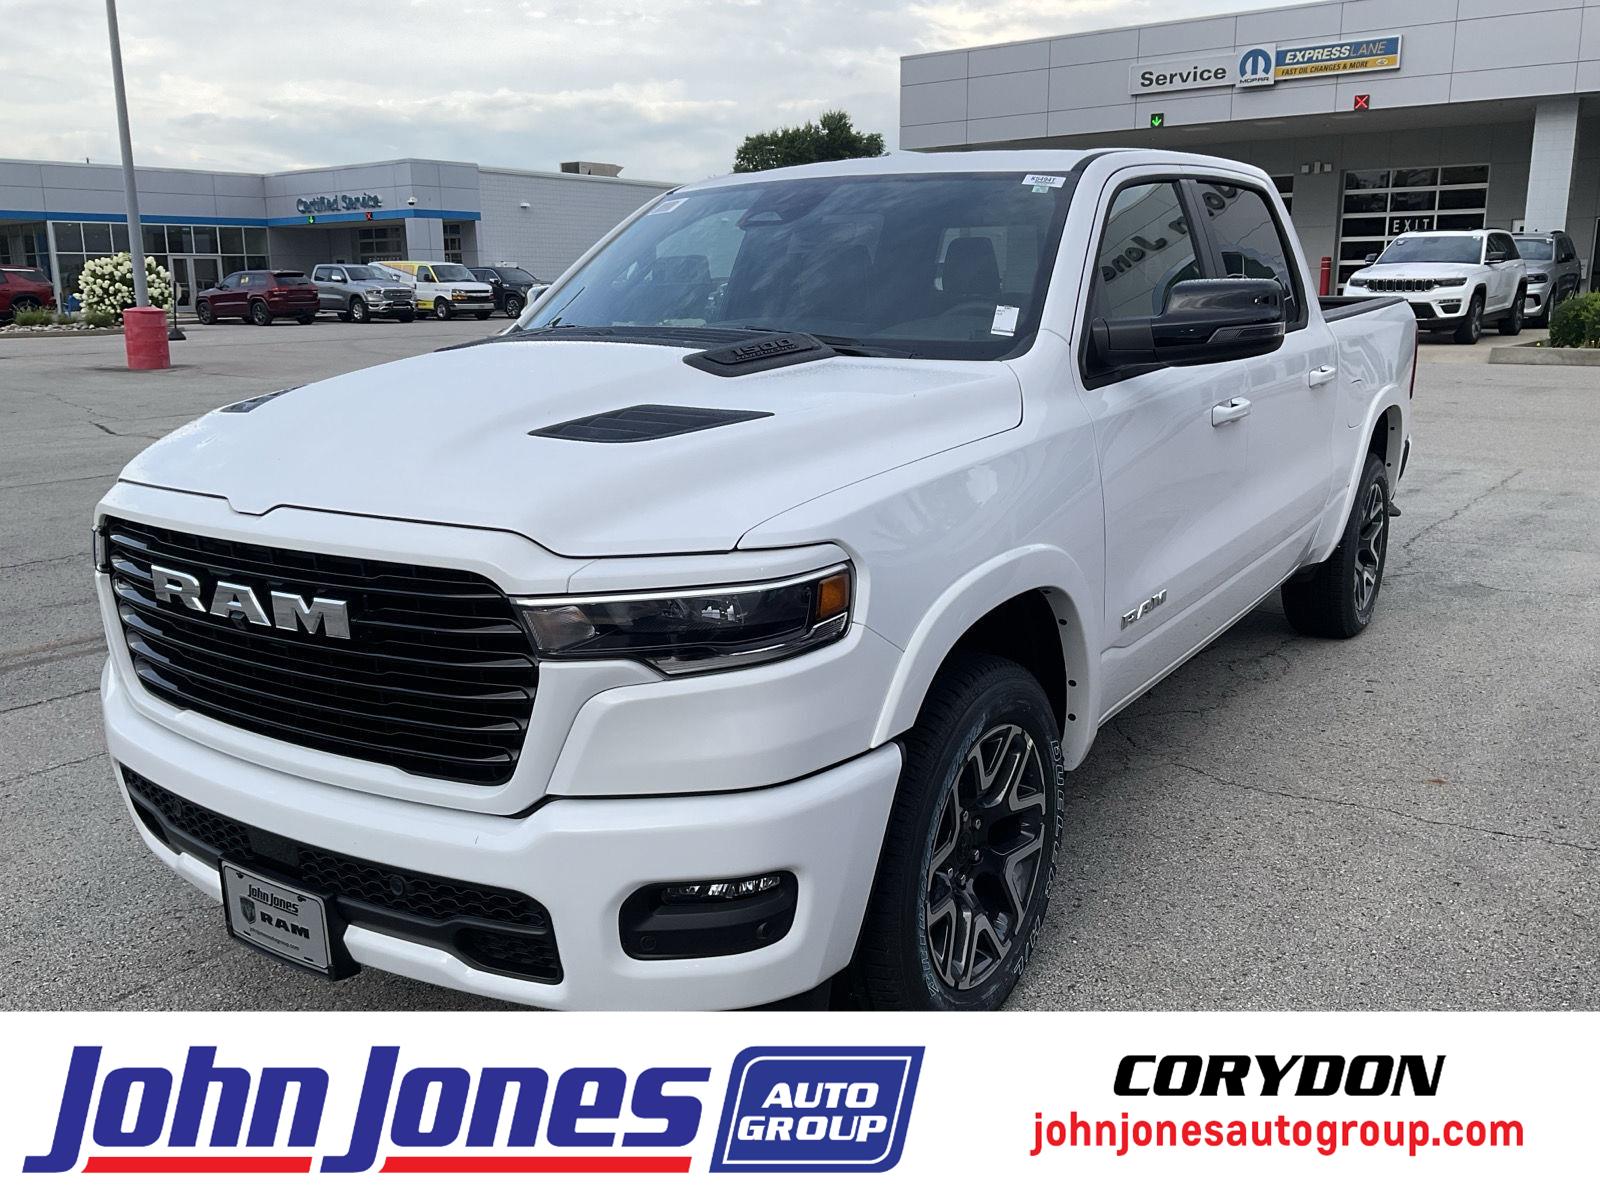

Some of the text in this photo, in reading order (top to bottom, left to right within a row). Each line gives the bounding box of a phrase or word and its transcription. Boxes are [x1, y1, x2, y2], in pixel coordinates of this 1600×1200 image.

[1140, 66, 1227, 88] Service
[1281, 68, 1297, 76] FAST
[1309, 64, 1342, 73] CHANGES
[1349, 61, 1369, 69] MORE
[1239, 76, 1270, 84] MOPAR
[296, 191, 382, 214] Certified Service
[1392, 218, 1430, 233] EXIT
[734, 338, 794, 356] 1500
[150, 564, 351, 640] RAM
[1120, 588, 1168, 631] RAM
[247, 884, 299, 913] John Jones
[260, 911, 310, 939] RAM
